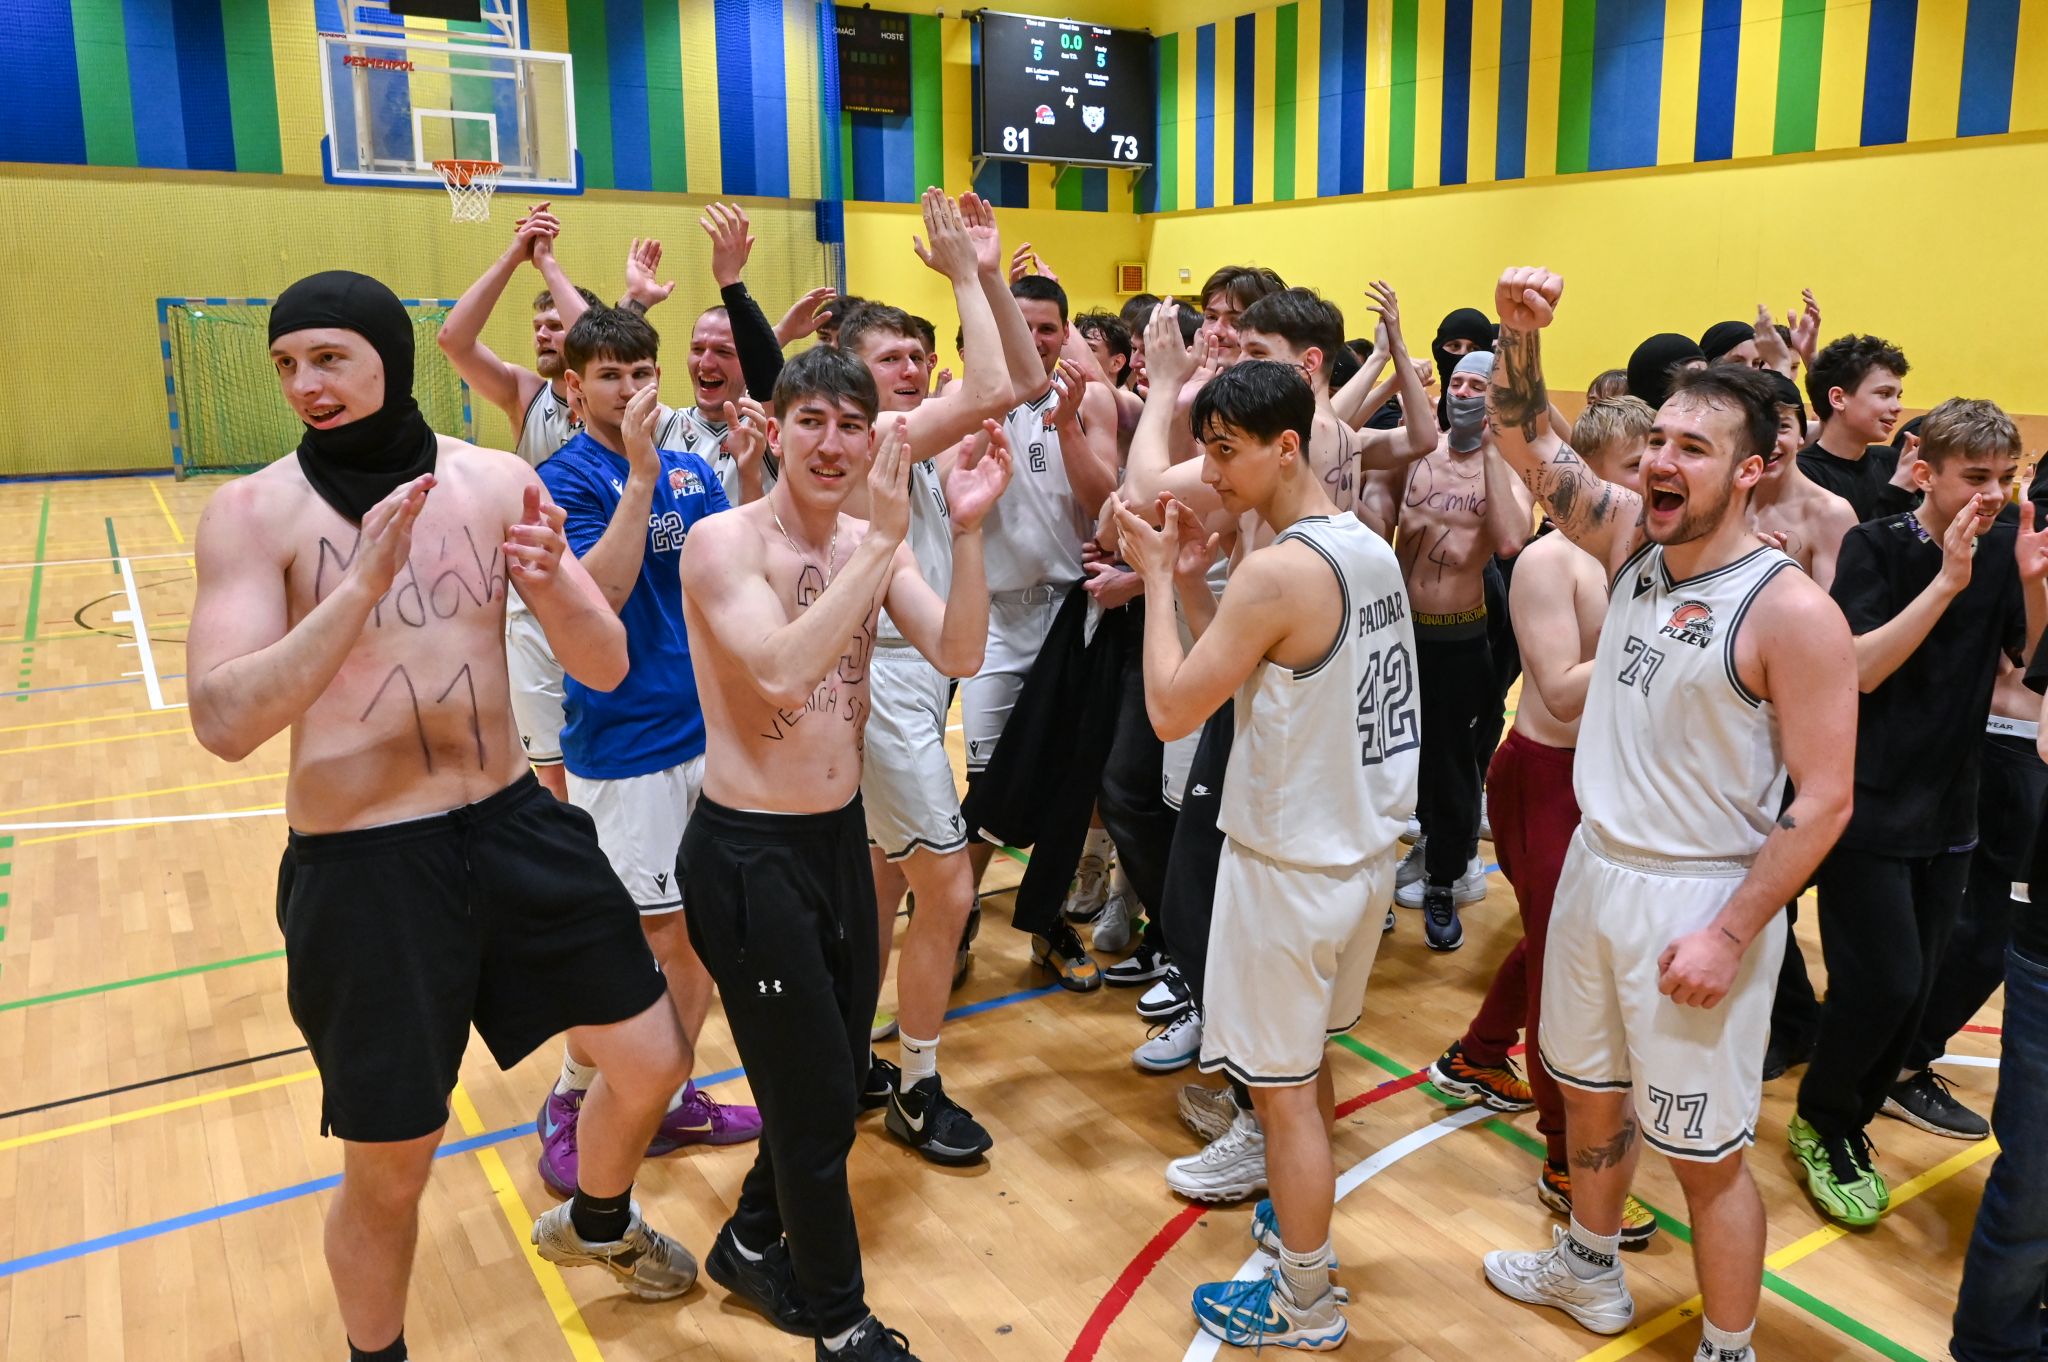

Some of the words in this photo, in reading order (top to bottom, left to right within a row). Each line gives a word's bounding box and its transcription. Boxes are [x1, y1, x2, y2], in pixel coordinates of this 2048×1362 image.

[1033, 46, 1042, 61] 5
[1061, 33, 1083, 50] 0.0
[343, 55, 415, 72] PESMENPOL
[1096, 53, 1106, 68] 5
[1065, 94, 1075, 109] 4
[1003, 126, 1029, 152] 81
[1111, 135, 1139, 160] 73
[1029, 442, 1046, 473] 2
[648, 510, 687, 553] 22
[1406, 524, 1455, 589] 14
[1359, 590, 1405, 638] PAIDAR
[1419, 613, 1456, 626] RONALDO
[1659, 625, 1711, 649] PLZEN
[1618, 634, 1666, 698] 77
[1356, 641, 1421, 766] 42
[360, 663, 486, 774] 11
[1648, 1084, 1708, 1140] 77
